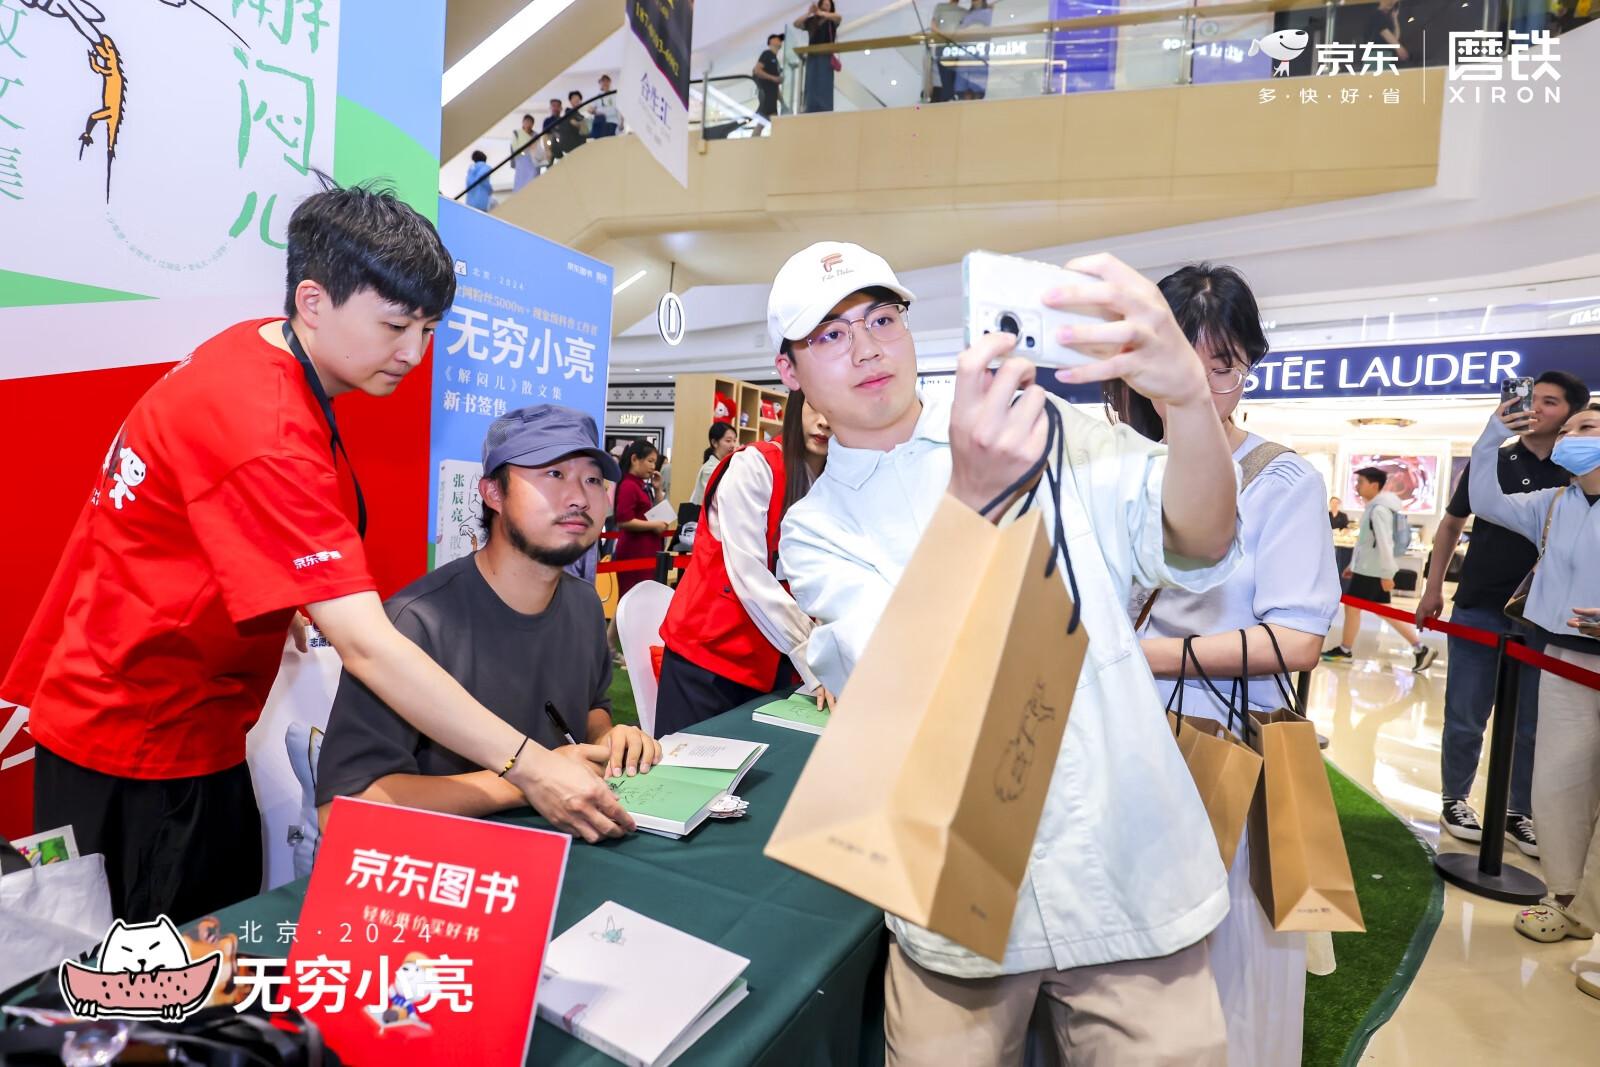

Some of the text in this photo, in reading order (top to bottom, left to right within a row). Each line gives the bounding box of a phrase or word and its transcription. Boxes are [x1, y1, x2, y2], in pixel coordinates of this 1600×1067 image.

[446, 304, 597, 385] 无穷小亮
[1338, 350, 1521, 389] LAUDER
[443, 390, 507, 418] 新书签售
[345, 848, 520, 915] 京东图书
